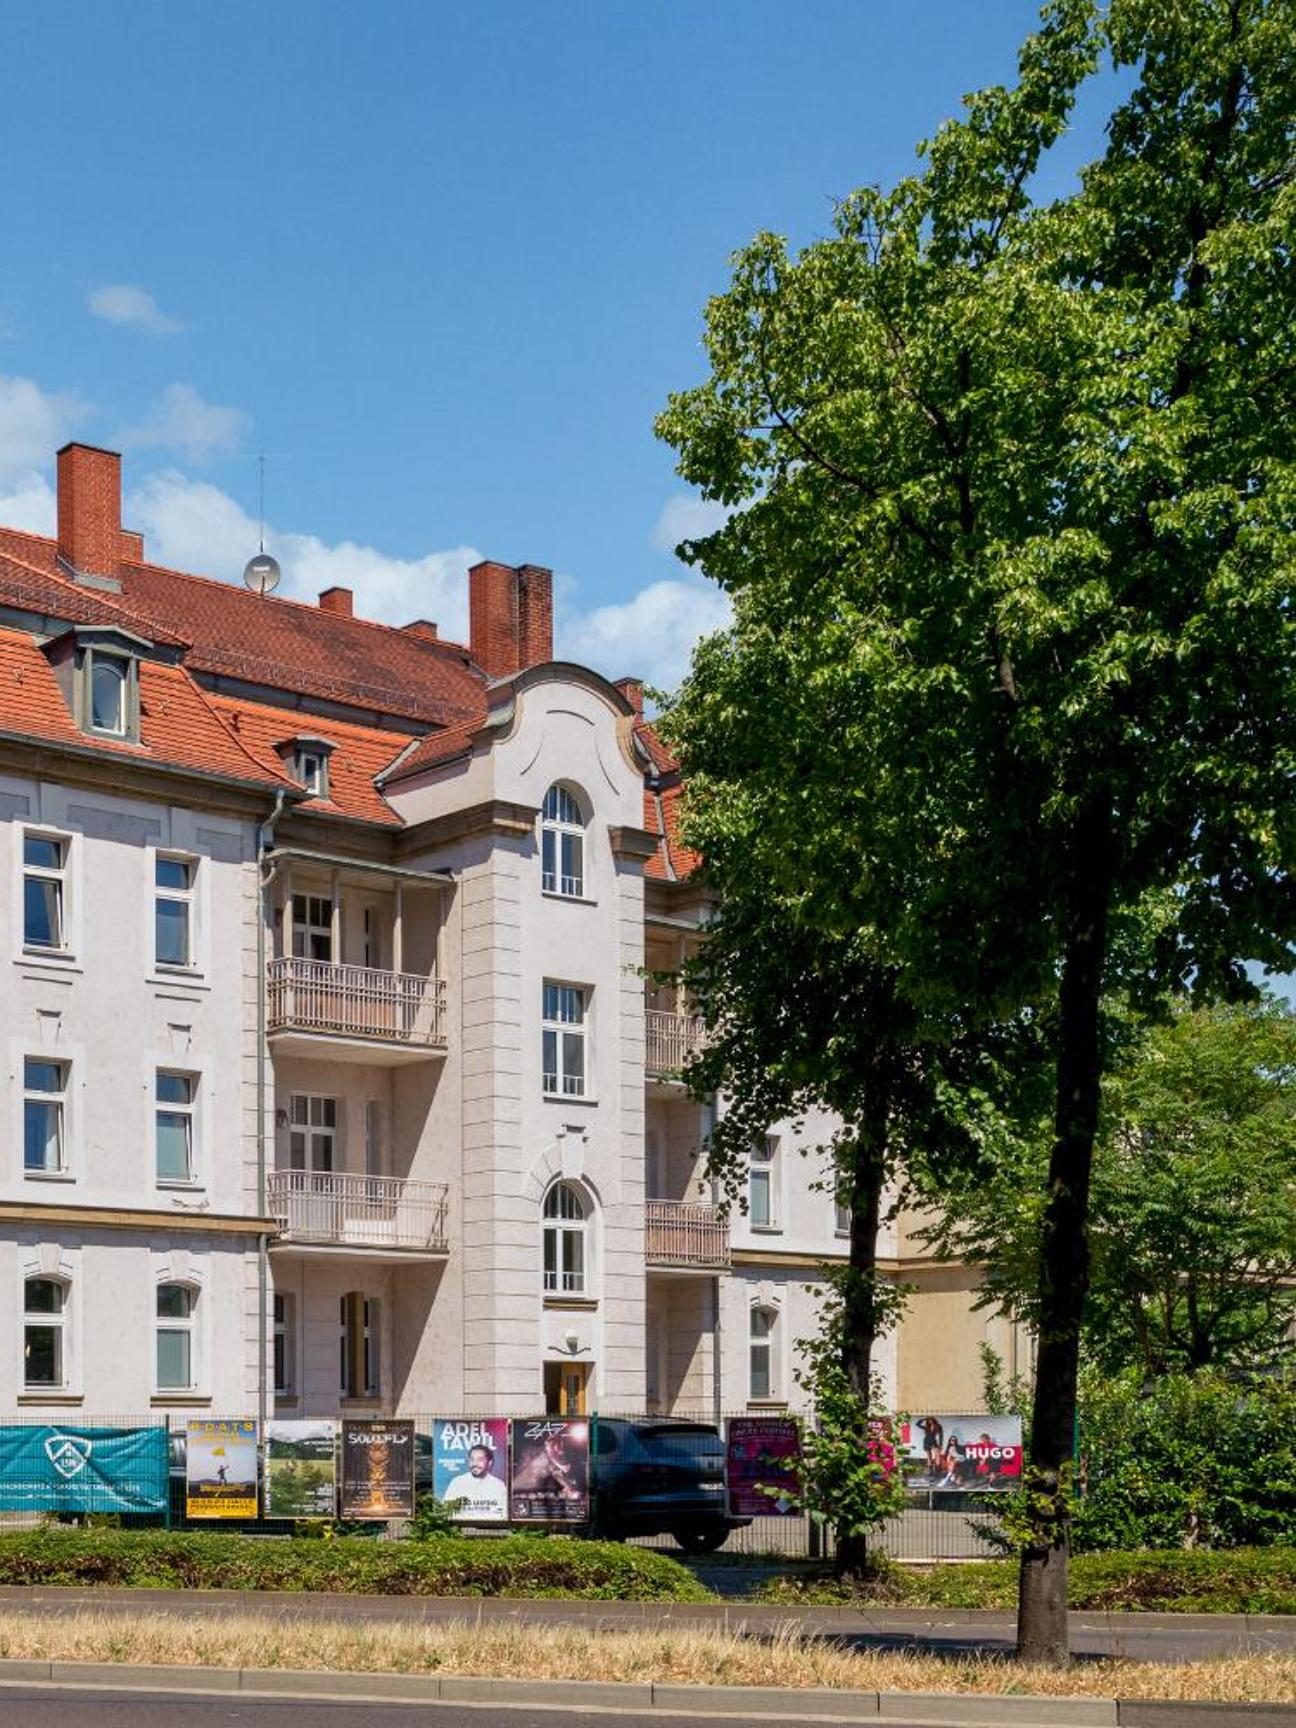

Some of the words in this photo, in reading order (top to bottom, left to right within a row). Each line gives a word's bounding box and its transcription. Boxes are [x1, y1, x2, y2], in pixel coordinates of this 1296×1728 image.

[442, 1422, 490, 1437] ADEL
[525, 1422, 569, 1440] ZAZ
[348, 1433, 409, 1444] SOULFLY
[440, 1436, 497, 1451] TAWIL
[965, 1447, 1016, 1459] HUGO
